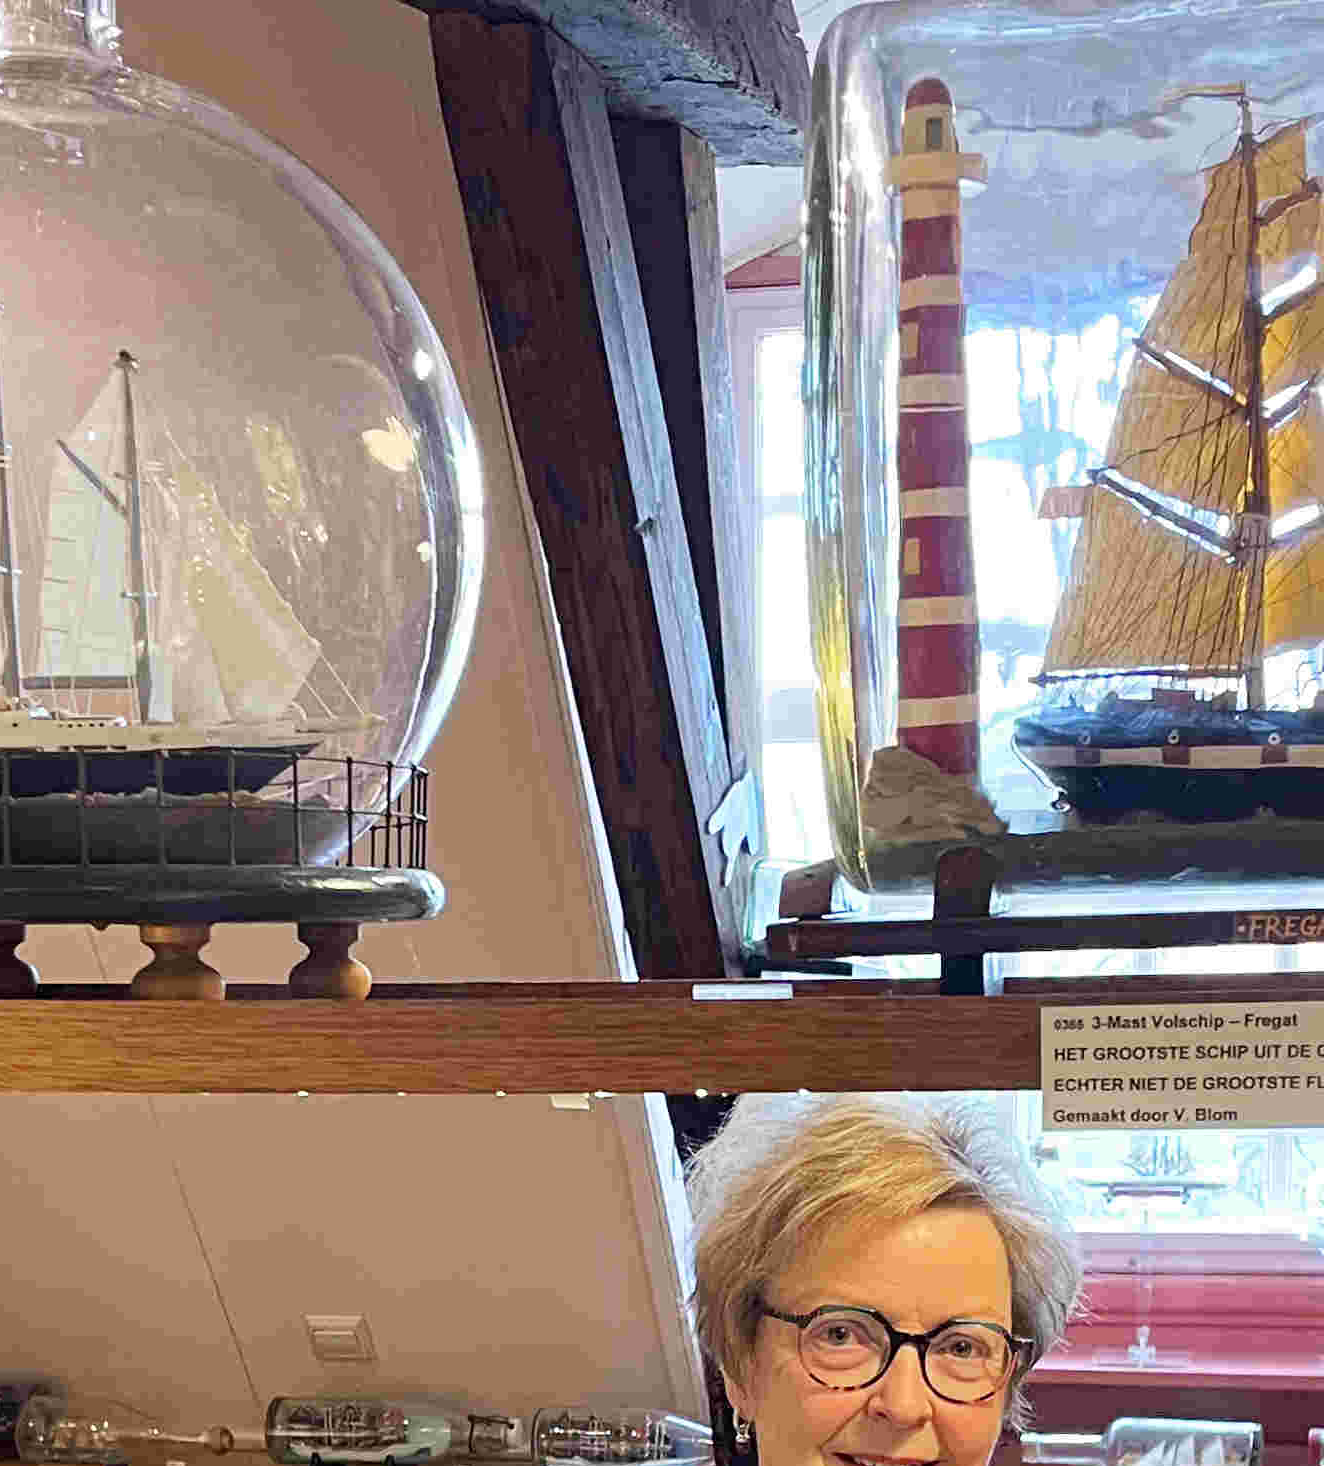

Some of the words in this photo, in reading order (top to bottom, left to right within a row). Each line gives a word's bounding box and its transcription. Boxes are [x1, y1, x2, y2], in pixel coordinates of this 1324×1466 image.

[1091, 1015, 1148, 1031] 3-Mast
[1151, 1013, 1225, 1032] Volschip
[1243, 1012, 1299, 1031] Fregat
[1053, 1047, 1089, 1062] HET
[1092, 1045, 1190, 1061] GROOTSTE
[1195, 1044, 1250, 1060] SCHIP
[1253, 1043, 1281, 1059] UIT
[1287, 1043, 1312, 1058] DE
[1053, 1077, 1125, 1093] ECHTER
[1128, 1077, 1170, 1092] NIET
[1174, 1076, 1198, 1091] DE
[1201, 1075, 1301, 1091] GROOTSTE
[1052, 1108, 1126, 1124] Gemaakt
[1130, 1107, 1170, 1123] door
[1173, 1107, 1189, 1122] V.
[1195, 1107, 1238, 1122] Blom
